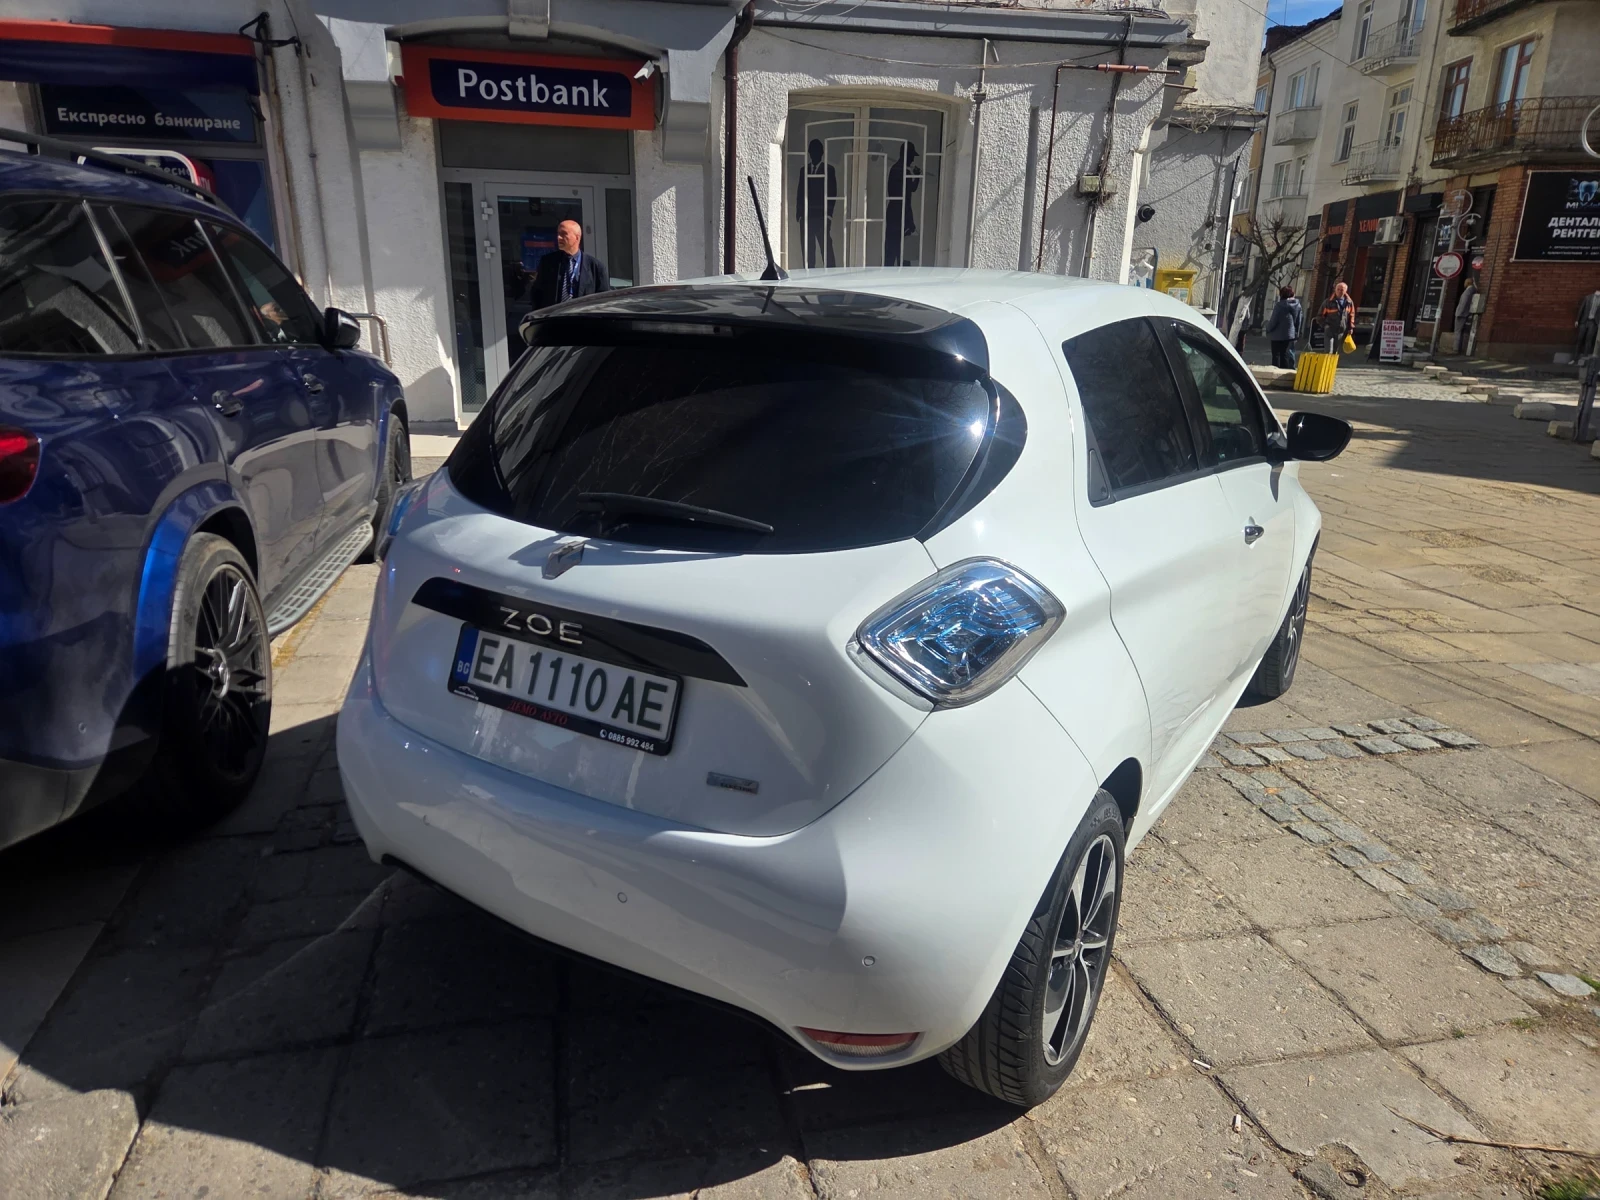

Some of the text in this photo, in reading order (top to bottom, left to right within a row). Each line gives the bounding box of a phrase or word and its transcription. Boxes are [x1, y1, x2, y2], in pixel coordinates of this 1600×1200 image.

[458, 68, 609, 107] Postbank
[57, 107, 241, 131] Експресно банкиране
[1548, 217, 1600, 228] ДЕНТАЛ
[500, 606, 583, 645] ZOE
[457, 660, 471, 675] BG
[473, 637, 668, 732] EA 1110 AE
[506, 699, 537, 716] ДЕМО
[608, 731, 655, 752] 0885 992 484
